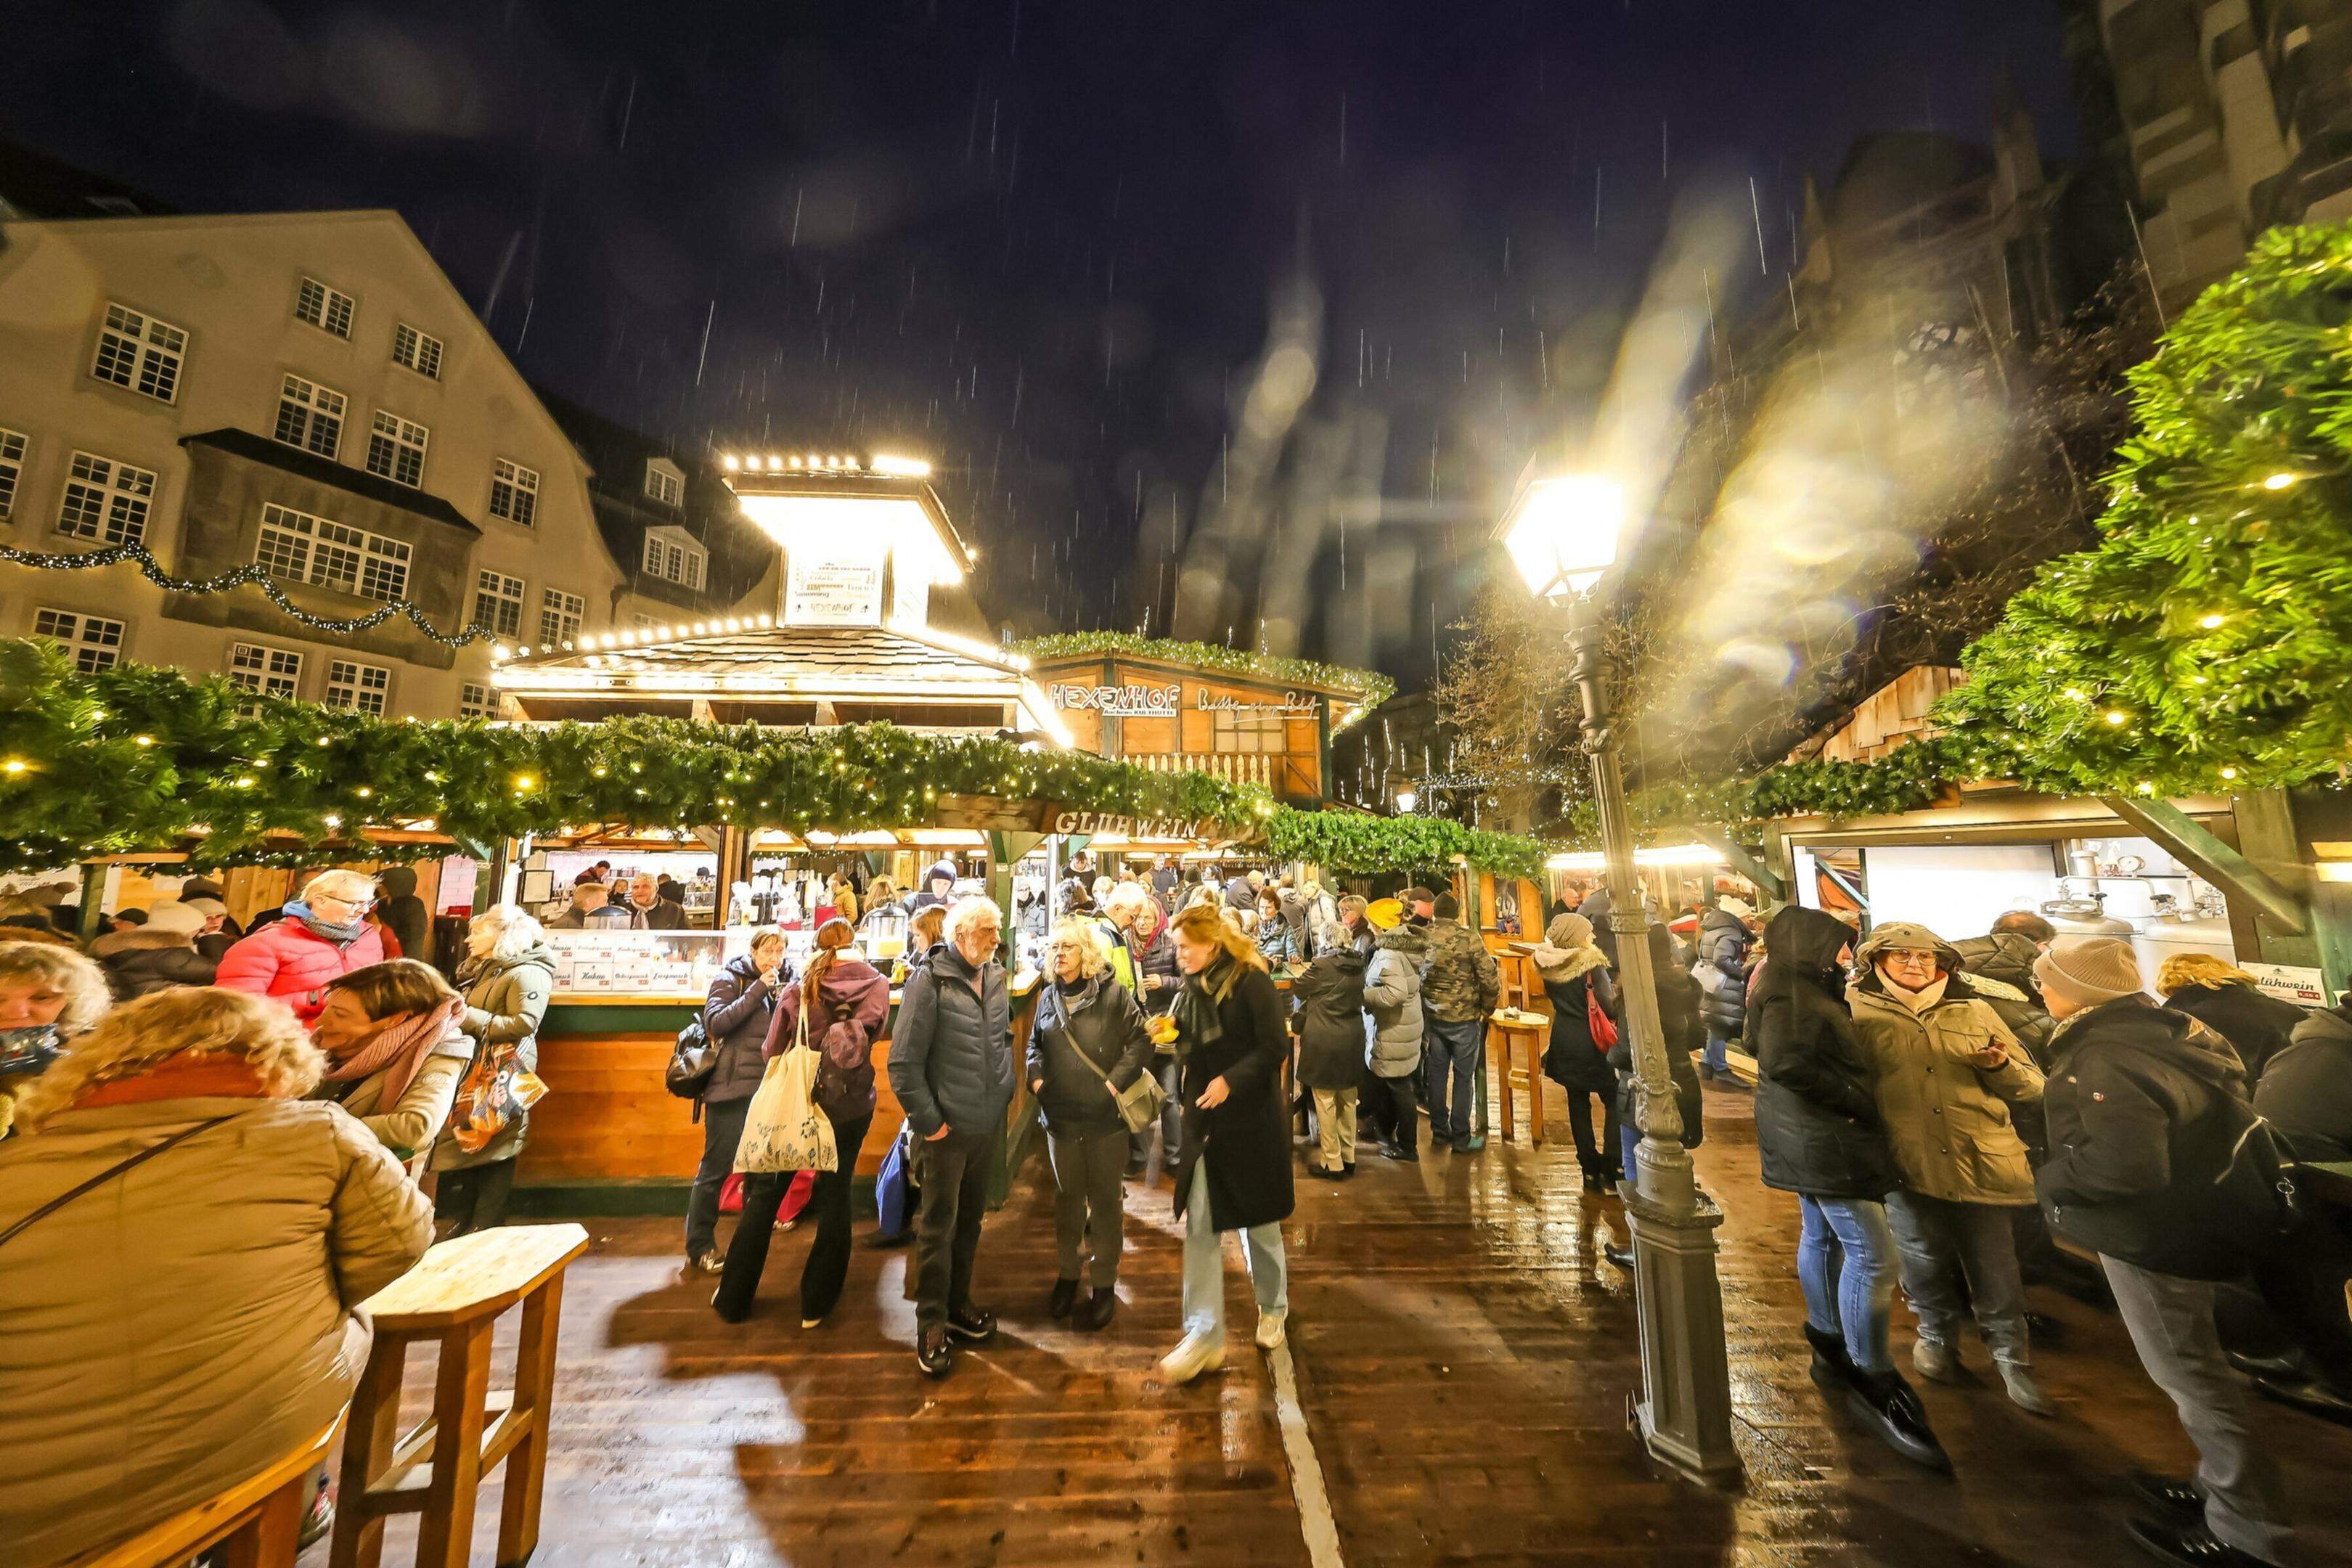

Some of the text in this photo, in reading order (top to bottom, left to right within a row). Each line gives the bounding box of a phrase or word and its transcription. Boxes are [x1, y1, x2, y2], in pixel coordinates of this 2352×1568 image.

[1050, 685, 1181, 709] HEXENHOF
[1198, 687, 1240, 712] Bitte
[1284, 691, 1323, 713] Bit
[2260, 976, 2314, 991] lühwein
